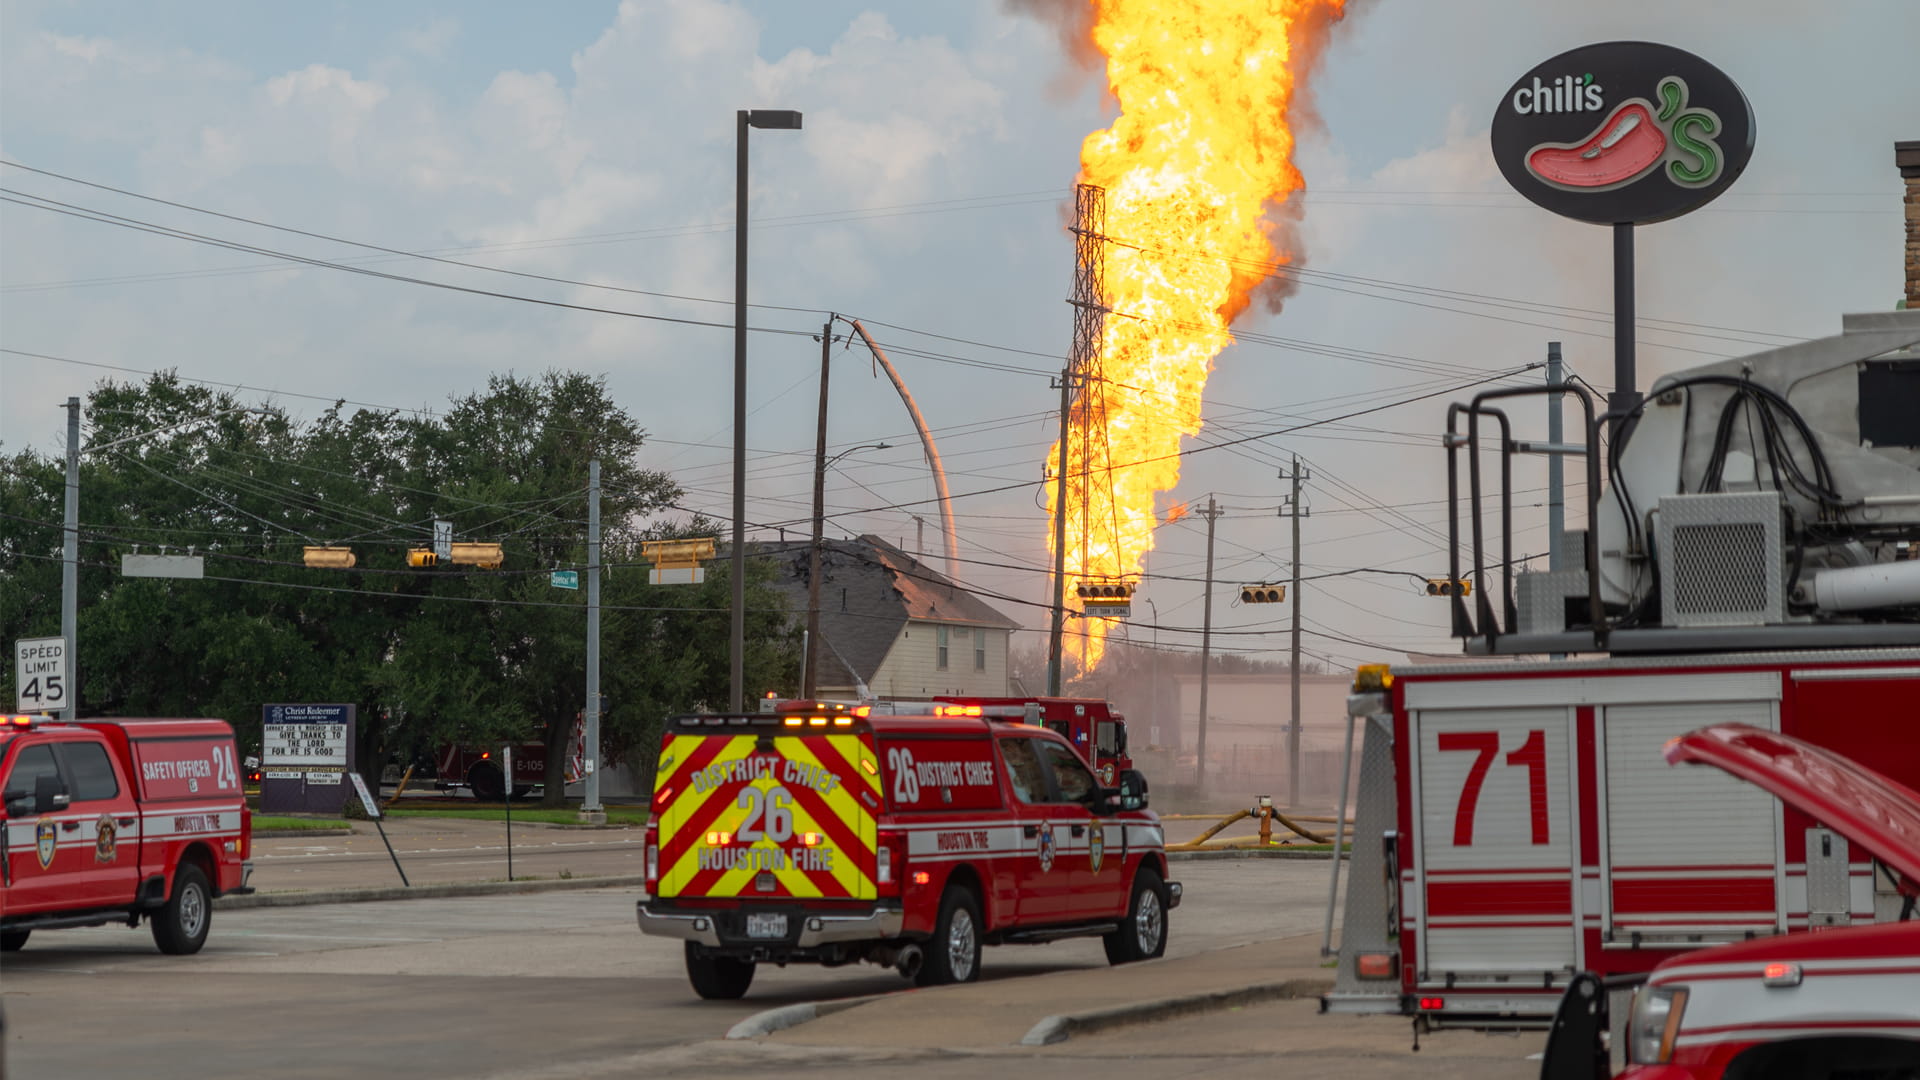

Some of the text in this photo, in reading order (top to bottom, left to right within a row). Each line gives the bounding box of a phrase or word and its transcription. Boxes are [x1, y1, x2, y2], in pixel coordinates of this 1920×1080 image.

[1513, 73, 1603, 114] chili's
[21, 646, 62, 660] SPEED
[25, 660, 58, 674] LIMIT
[22, 675, 63, 703] 45
[285, 706, 341, 715] Christ Redeemer
[279, 731, 341, 739] GIVE THANKS TO
[271, 748, 334, 756] FOR HE IS GOOD
[143, 745, 237, 789] SAFETY OFFICER 24
[517, 760, 544, 771] E-105
[691, 757, 842, 796] DISTRICT CHIEF
[888, 748, 993, 803] 26 DISTRICT CHIEF
[1437, 729, 1550, 847] 71
[174, 813, 221, 833] HOUSTON FIRE
[737, 786, 793, 842] 26
[937, 831, 989, 851] HOUSTON FIRE
[697, 847, 833, 871] HOUSTON FIRE
